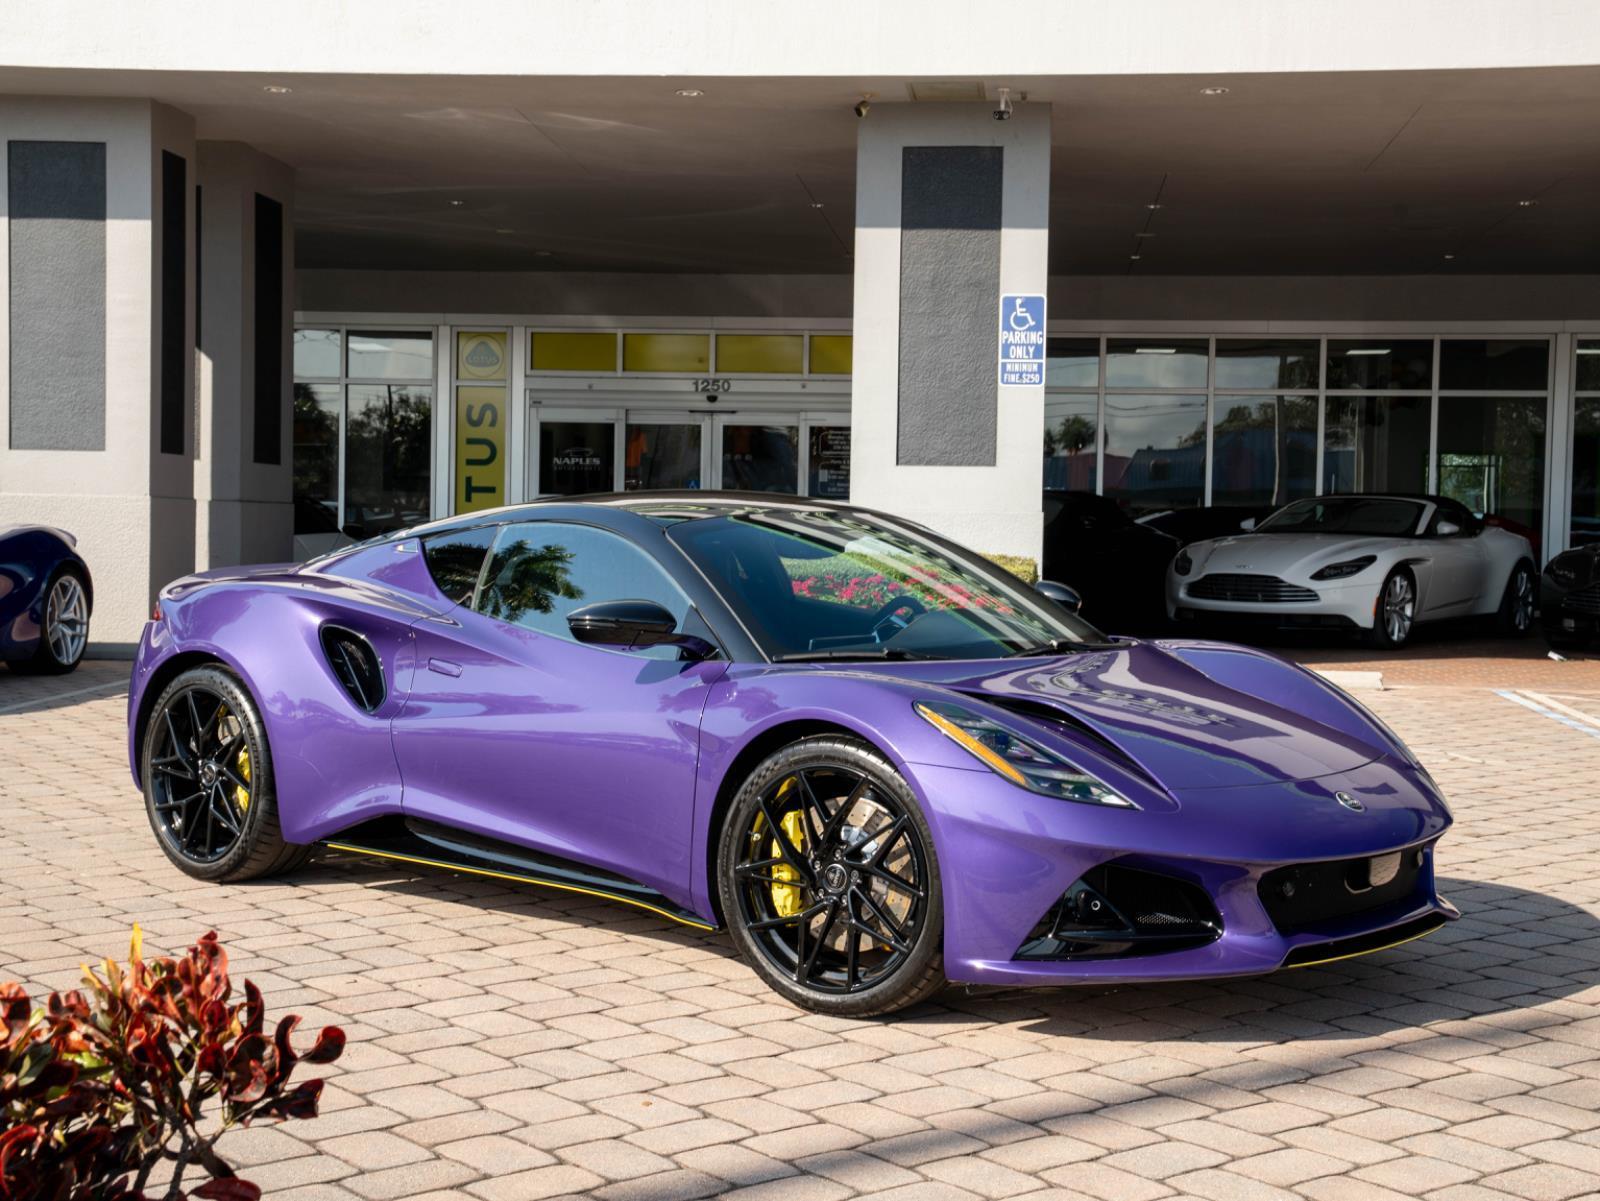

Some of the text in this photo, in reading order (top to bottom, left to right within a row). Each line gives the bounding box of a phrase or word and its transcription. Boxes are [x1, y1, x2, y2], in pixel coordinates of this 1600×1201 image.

[1002, 331, 1043, 344] PARKING
[1009, 345, 1035, 359] ONLY
[1006, 363, 1038, 372] MINIMUM
[692, 378, 731, 392] 1250
[552, 456, 601, 465] NAPLES
